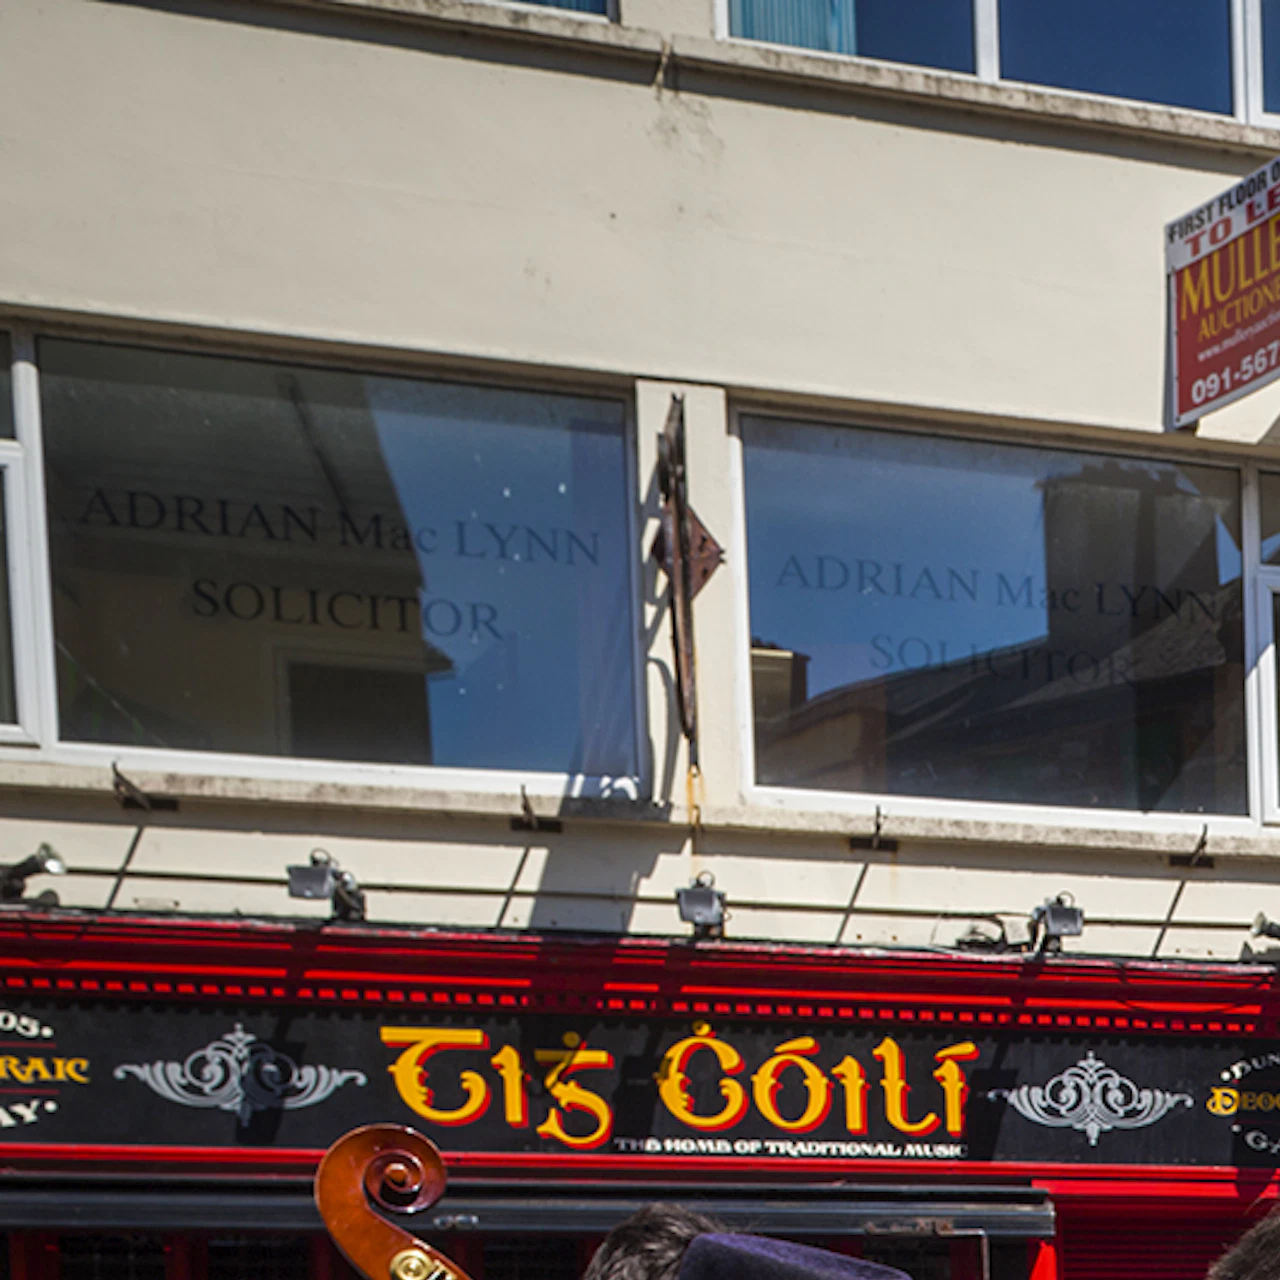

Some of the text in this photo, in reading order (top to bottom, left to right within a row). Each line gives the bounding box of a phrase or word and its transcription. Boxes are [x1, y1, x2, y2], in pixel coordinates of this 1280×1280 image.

[1168, 203, 1214, 243] FIRST
[1218, 171, 1267, 215] FLOOR
[1185, 216, 1232, 257] TO
[77, 487, 601, 567] ADRIAN Mac LYNN
[191, 577, 504, 642] SOLICITOR
[774, 553, 1219, 625] ADRIAN Mac LYNN
[869, 632, 1136, 686] SOLICITOR
[0, 1055, 90, 1083] RAIC
[614, 1137, 968, 1158] THE HOME OF TRADITIONAL MUSIC
